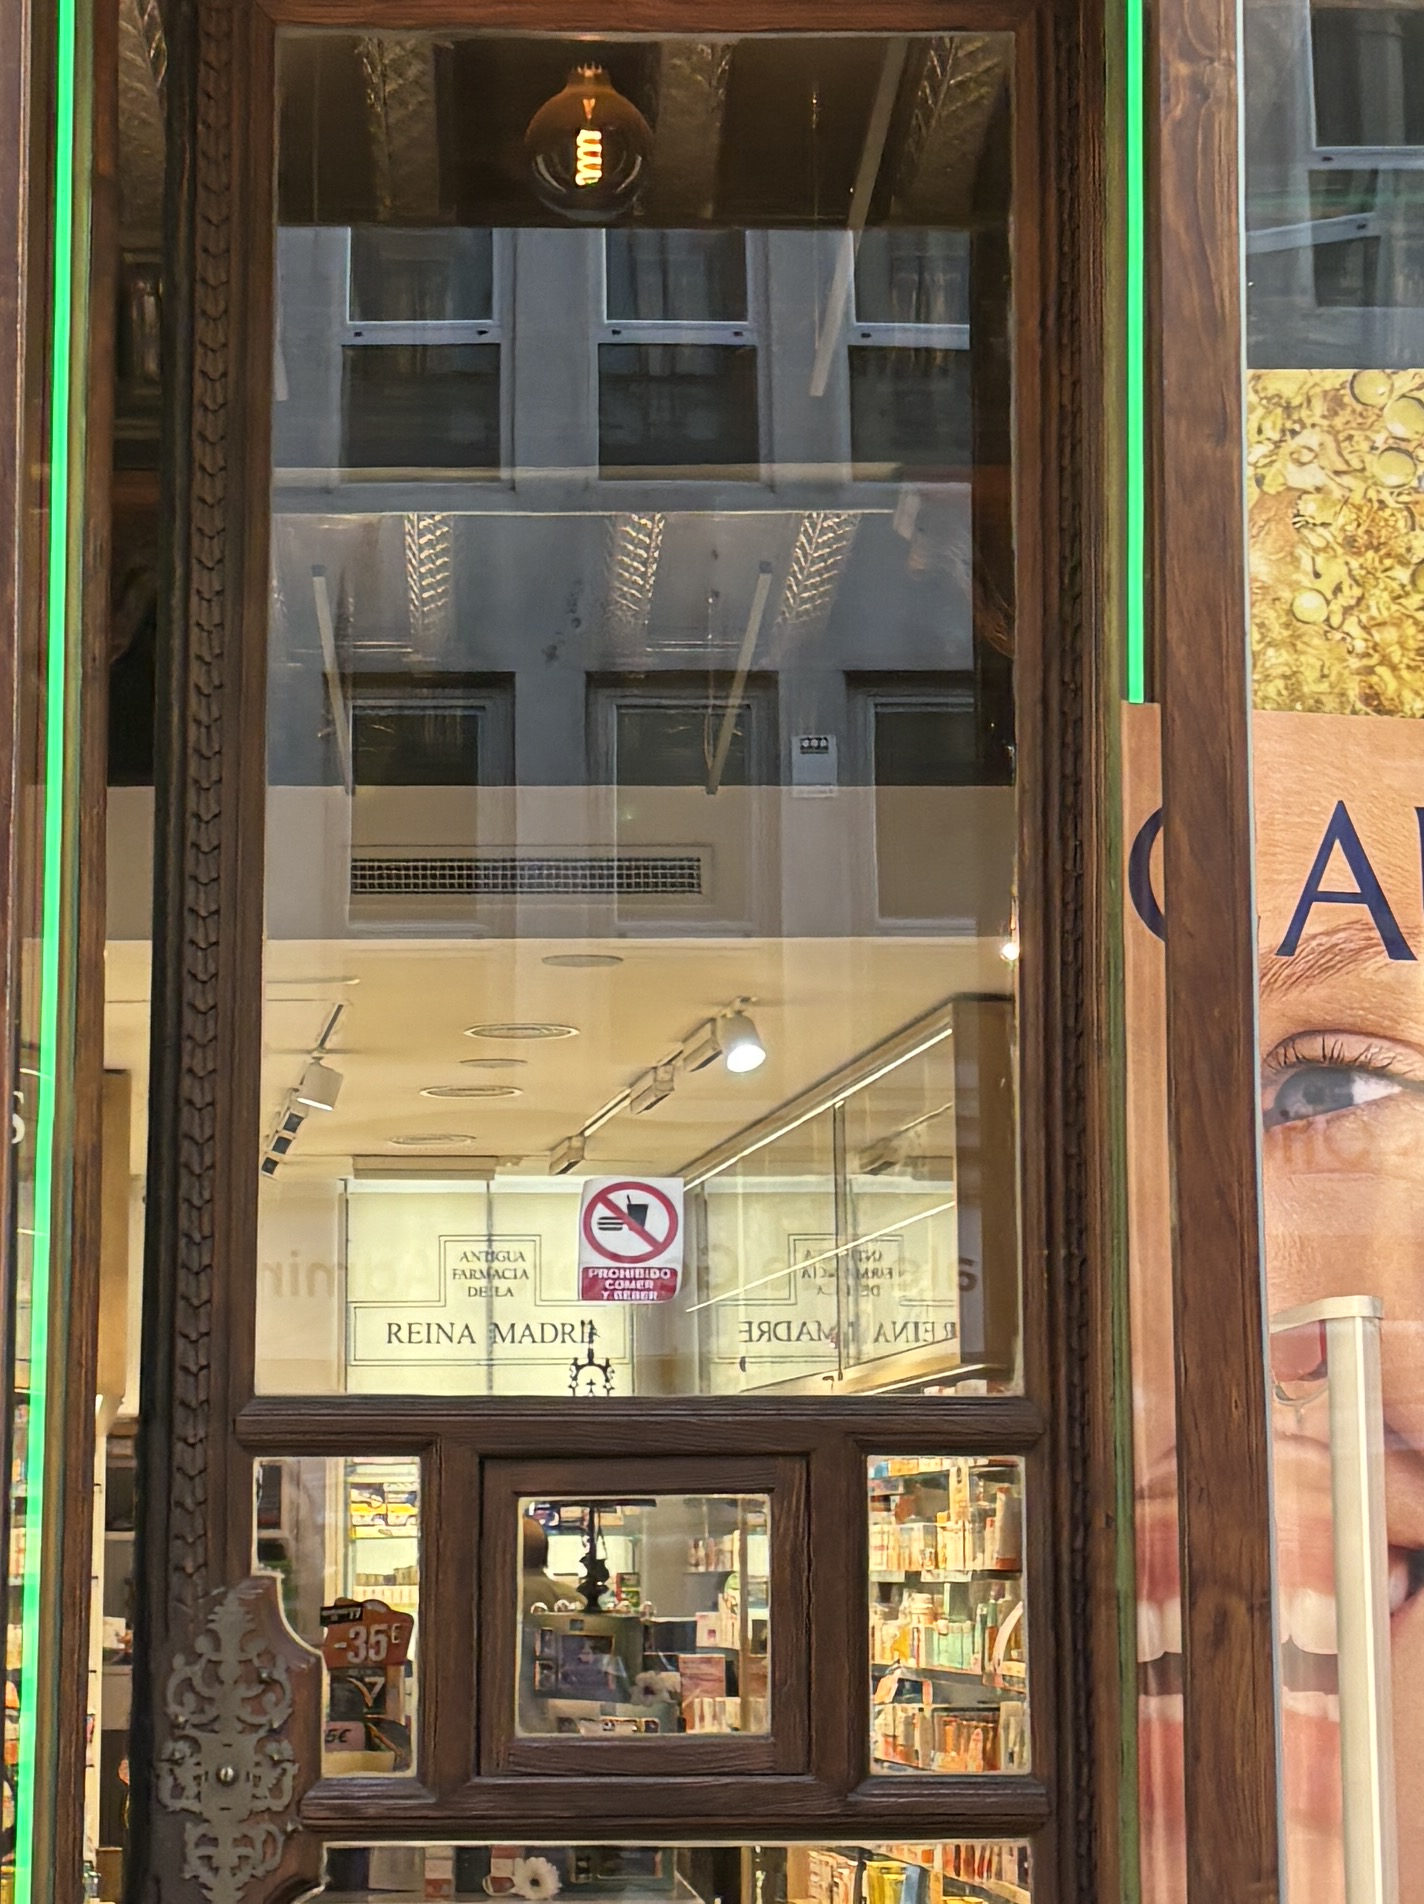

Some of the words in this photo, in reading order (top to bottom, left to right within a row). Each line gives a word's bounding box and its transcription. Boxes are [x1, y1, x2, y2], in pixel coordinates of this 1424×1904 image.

[459, 1250, 526, 1263] ANTIGUA
[452, 1268, 530, 1280] FARMACIA
[588, 1268, 671, 1279] PROHIBIDO
[604, 1280, 654, 1290] COMER
[468, 1286, 488, 1298] DE
[602, 1291, 611, 1300] Y
[386, 1322, 476, 1345] REINA
